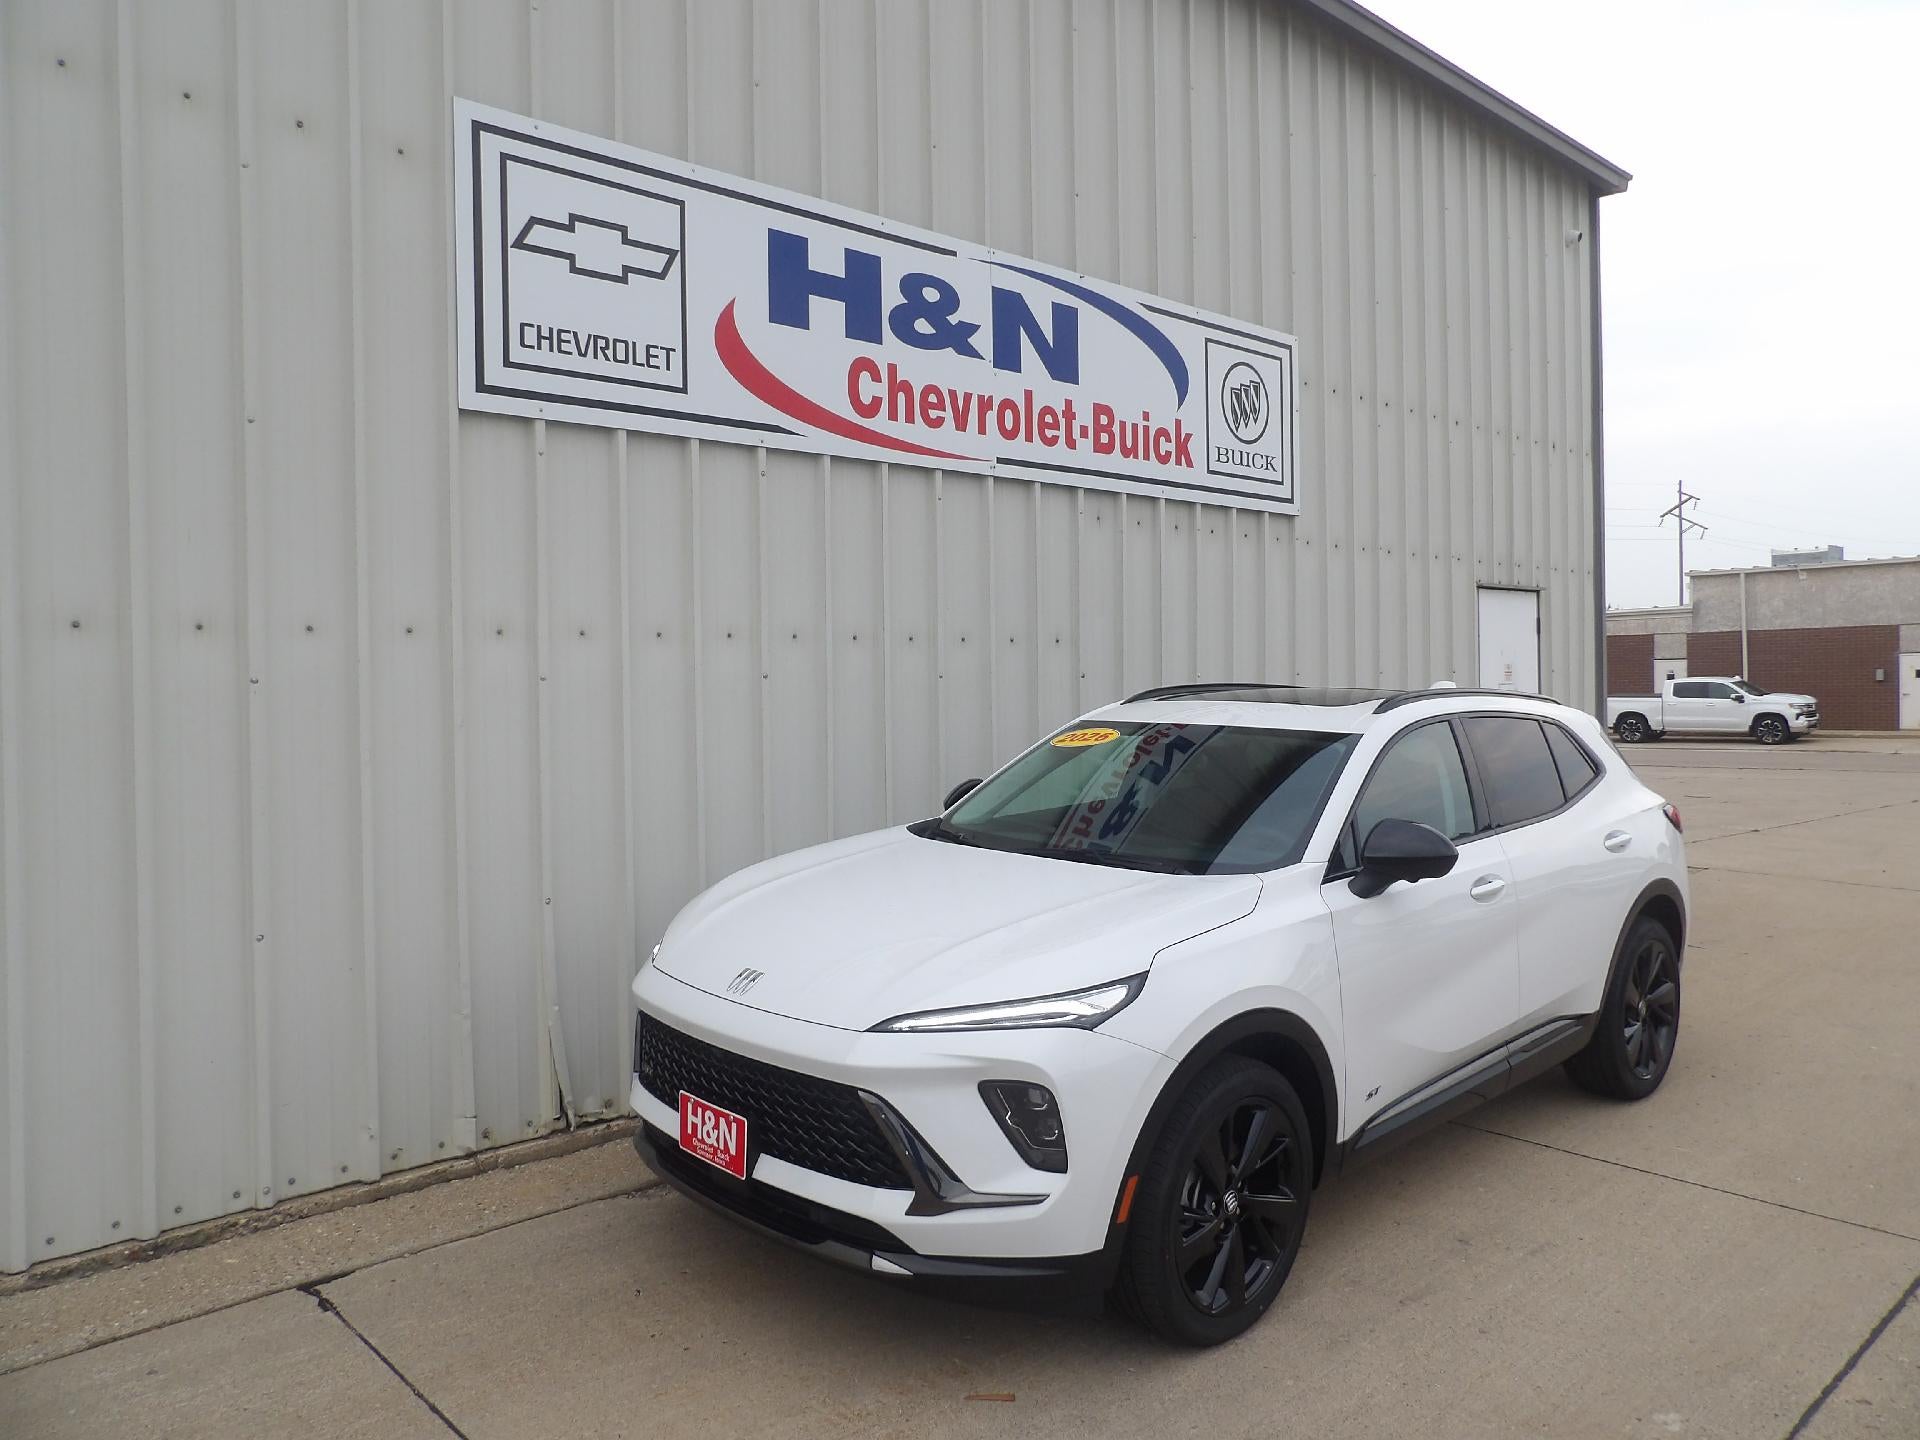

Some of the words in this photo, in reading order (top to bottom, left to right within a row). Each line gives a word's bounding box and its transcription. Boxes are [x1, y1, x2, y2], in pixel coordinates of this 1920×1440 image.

[768, 228, 1079, 385] H&N
[520, 322, 676, 371] CHEVROLET
[1215, 446, 1278, 472] BUICK
[1365, 1085, 1381, 1102] ST
[687, 1102, 737, 1156] H&N
